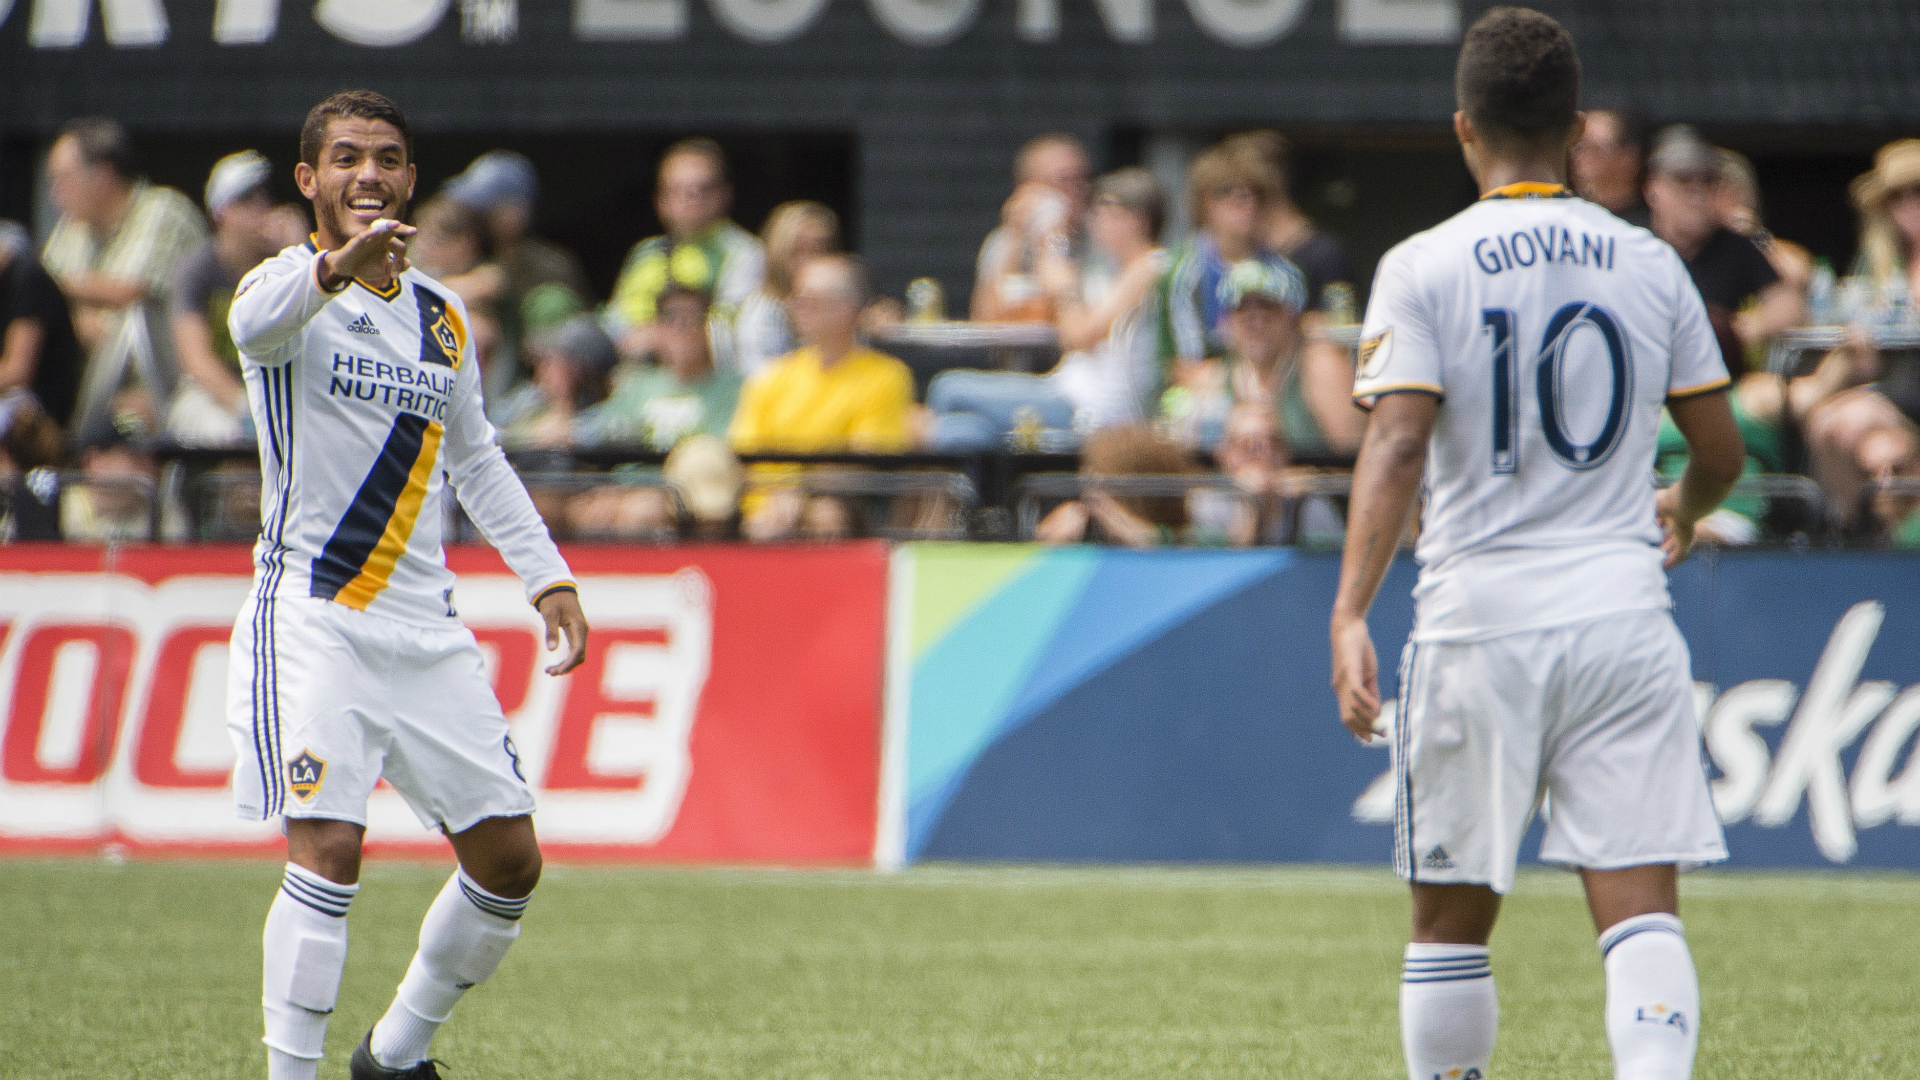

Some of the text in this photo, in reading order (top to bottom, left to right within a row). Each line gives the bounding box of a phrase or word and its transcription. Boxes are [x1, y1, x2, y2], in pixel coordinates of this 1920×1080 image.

[1474, 226, 1615, 274] GIOVANI
[347, 324, 380, 335] adidas
[1481, 300, 1634, 474] 10
[292, 766, 316, 782] LA
[1634, 1006, 1688, 1035] LA
